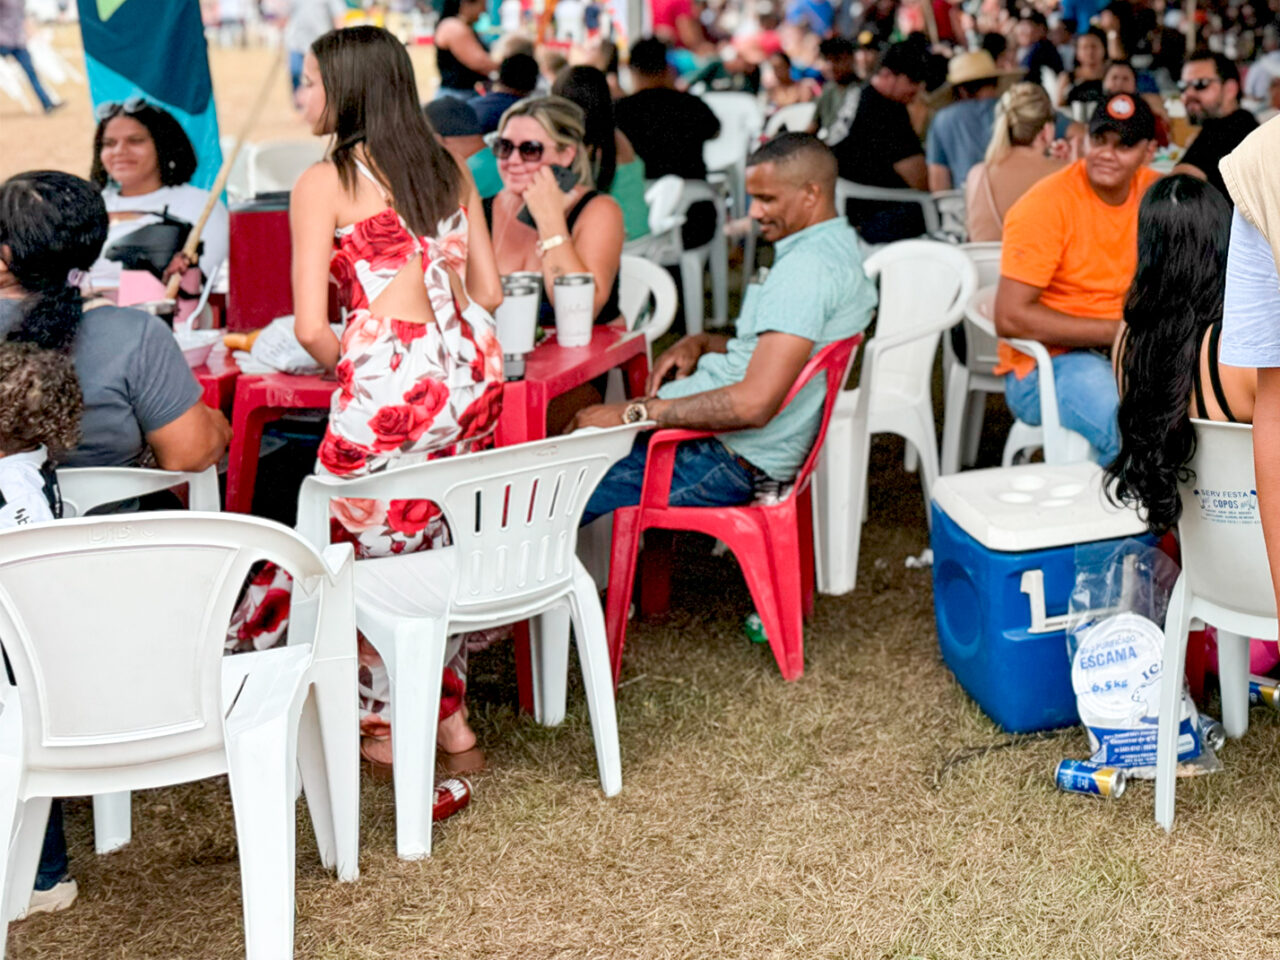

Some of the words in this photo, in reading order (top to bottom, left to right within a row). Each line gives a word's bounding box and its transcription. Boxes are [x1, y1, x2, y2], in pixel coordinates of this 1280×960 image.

[1201, 489, 1220, 497] SERV
[1213, 499, 1239, 509] COPOS
[1080, 646, 1138, 670] ESCAMA
